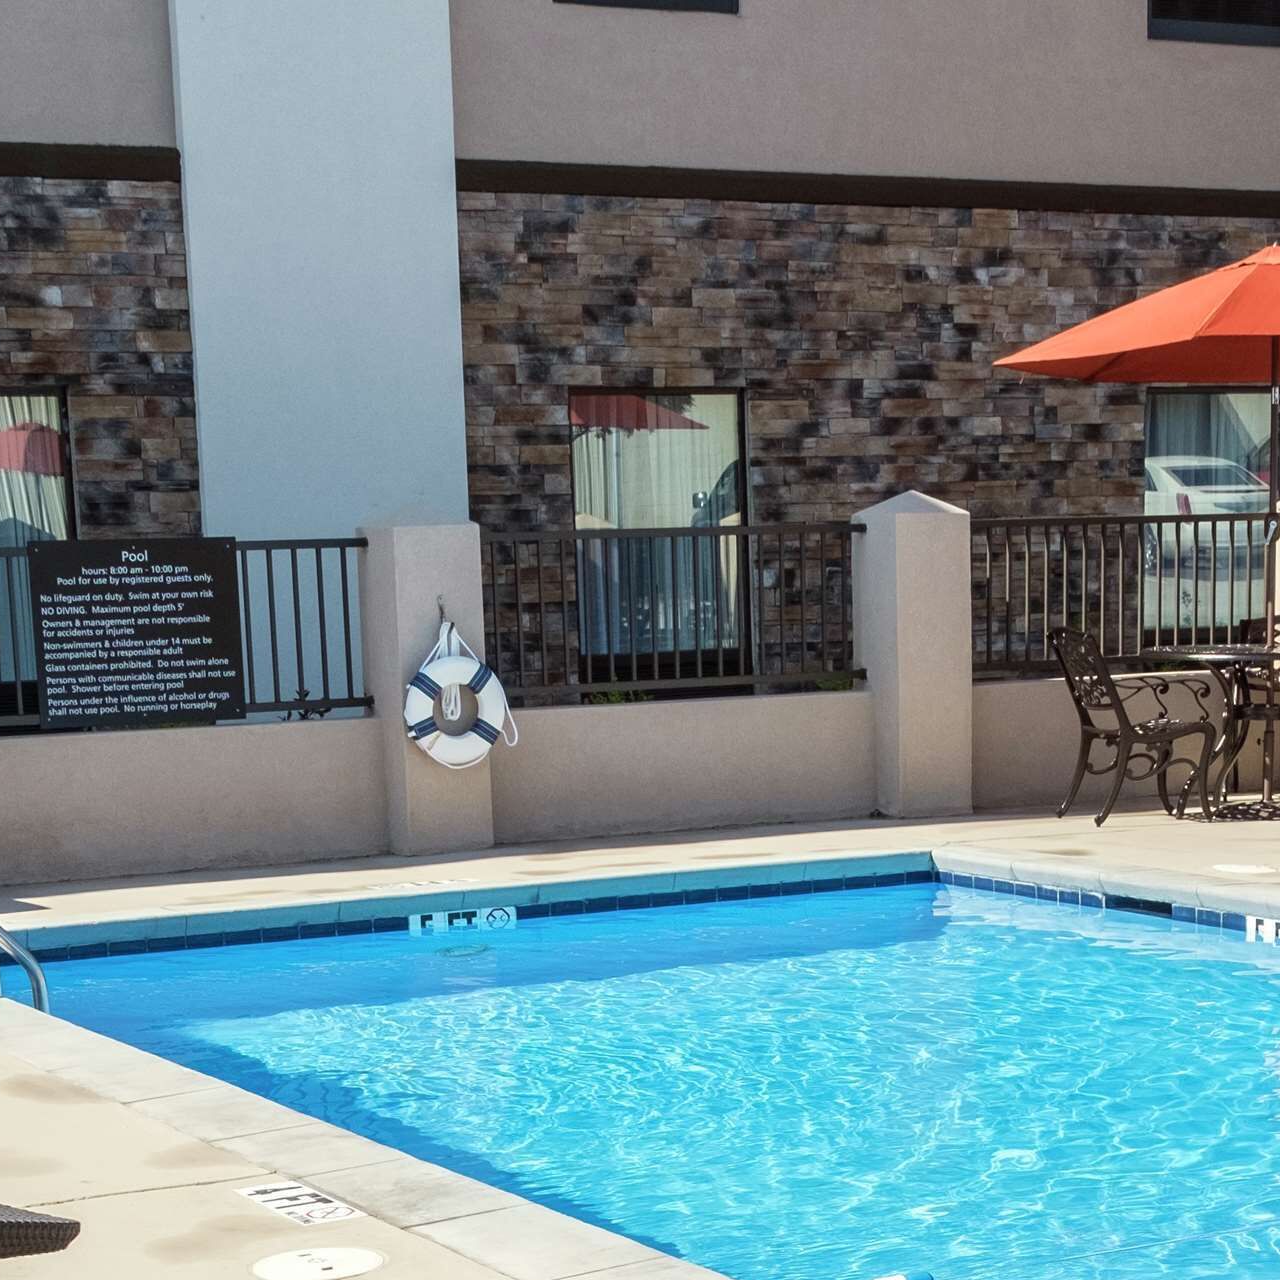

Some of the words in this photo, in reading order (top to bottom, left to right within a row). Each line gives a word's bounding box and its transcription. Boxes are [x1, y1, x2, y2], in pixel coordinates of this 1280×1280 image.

[121, 550, 148, 562] Pool
[82, 567, 108, 575] hours:
[151, 565, 172, 573] 10:00
[175, 565, 188, 574] pm
[57, 577, 76, 585] Pool
[109, 576, 119, 585] by
[122, 575, 163, 585] registered
[166, 575, 192, 584] guests
[194, 573, 213, 583] only.
[40, 595, 52, 603] No
[54, 593, 90, 603] lifeguard
[105, 593, 124, 602] duty.
[129, 592, 149, 600] Swim
[162, 593, 179, 601] your
[41, 607, 54, 615] NO
[56, 606, 87, 614] DIVING.
[92, 605, 131, 613] Maximum
[133, 604, 150, 613] pool
[152, 603, 175, 612] depth
[42, 620, 72, 628] Owners
[75, 619, 81, 627] &
[83, 618, 135, 627] management
[167, 615, 210, 625] responsible
[43, 629, 55, 637] for
[57, 628, 93, 637] accidents
[106, 627, 134, 637] injuries
[44, 641, 102, 650] Non-swimmers
[112, 639, 143, 647] children
[146, 638, 168, 646] under
[203, 636, 212, 644] be
[45, 650, 96, 660] accompanied
[99, 650, 108, 659] by
[117, 647, 160, 657] responsible
[45, 664, 65, 672] Glass
[110, 660, 153, 670] prohibited.
[158, 659, 169, 667] Do
[186, 658, 205, 666] swim
[208, 657, 229, 665] alone
[79, 675, 96, 683] with
[98, 673, 154, 682] communicable
[156, 672, 187, 680] diseases
[189, 670, 206, 678] shall
[47, 686, 67, 695] pool.
[72, 685, 100, 693] Shower
[132, 682, 164, 691] entering
[166, 681, 184, 690] pool
[80, 697, 103, 705] under
[120, 695, 156, 703] influence
[158, 693, 166, 701] of
[169, 692, 196, 700] alcohol
[208, 691, 229, 700] drugs
[49, 707, 66, 716] shall
[100, 705, 120, 715] pool.
[138, 703, 168, 712] running
[180, 701, 217, 710] horseplay
